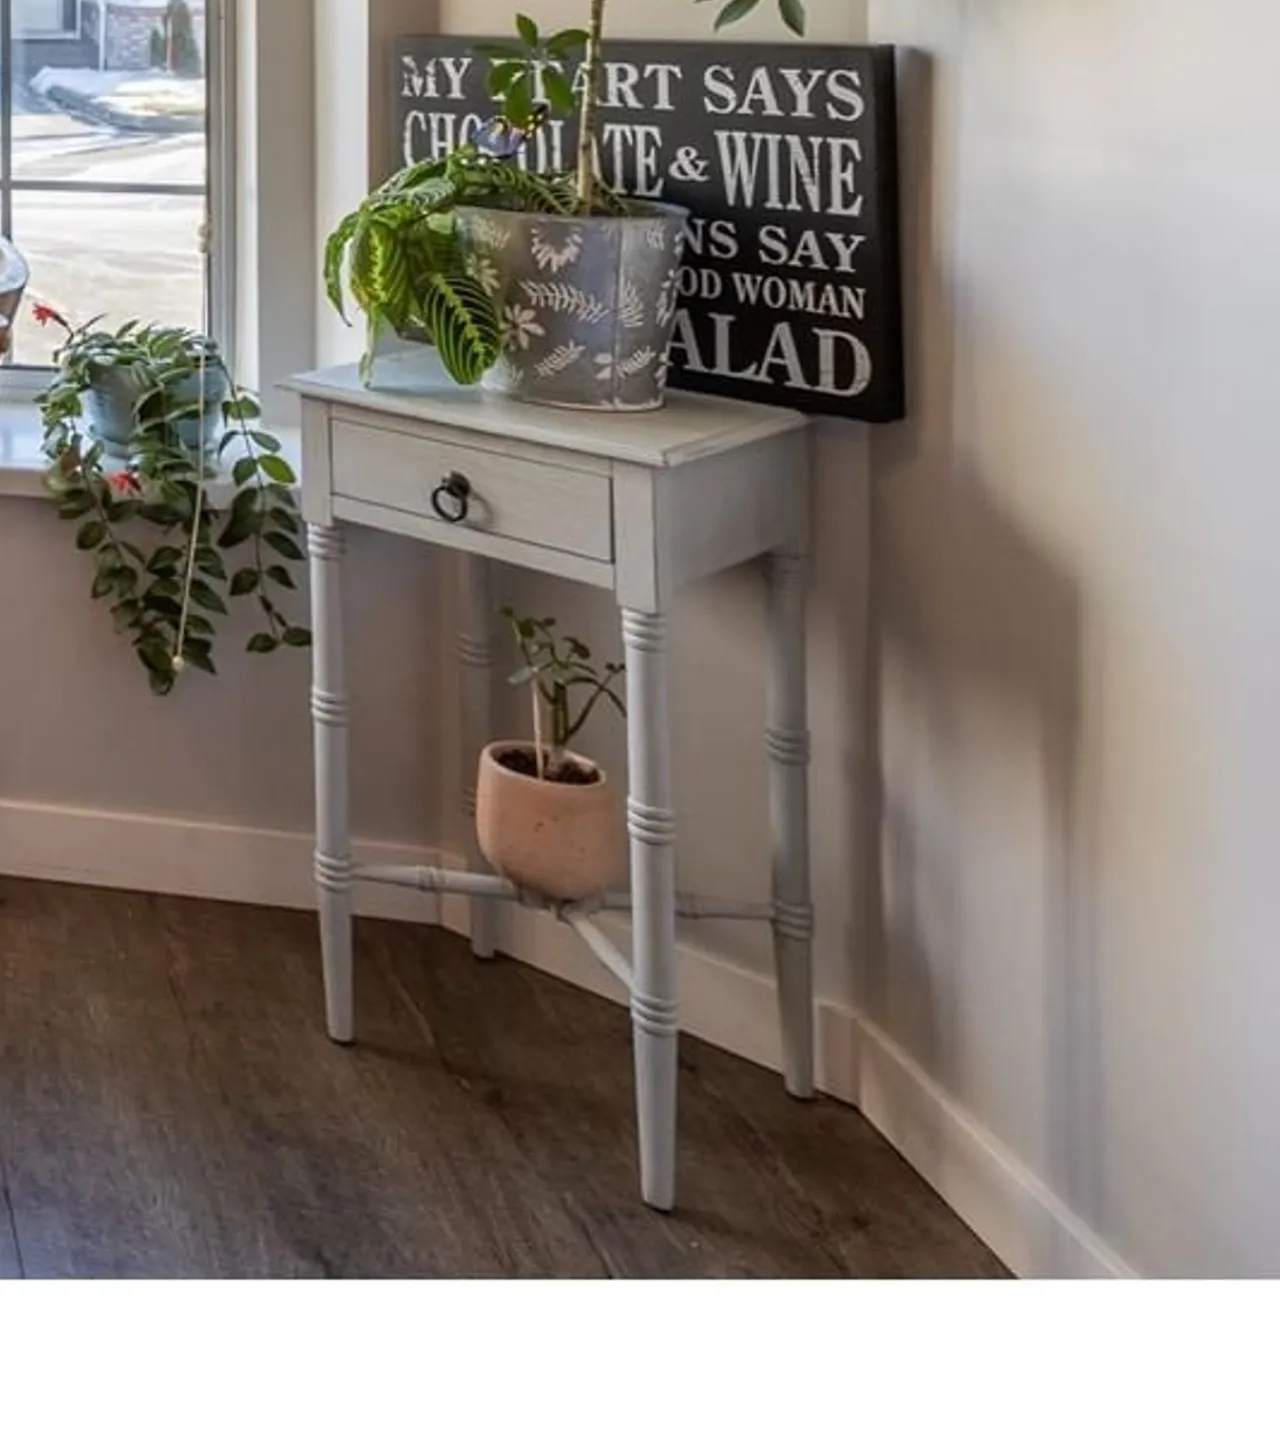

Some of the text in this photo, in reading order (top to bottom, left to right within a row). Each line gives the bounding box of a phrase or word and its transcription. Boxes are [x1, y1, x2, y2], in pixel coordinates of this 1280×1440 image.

[400, 56, 472, 100] MY
[703, 64, 865, 122] SAYS
[668, 145, 710, 183] &
[713, 129, 863, 217] WINE
[758, 224, 867, 273] SAY
[731, 271, 867, 320] WOMAN
